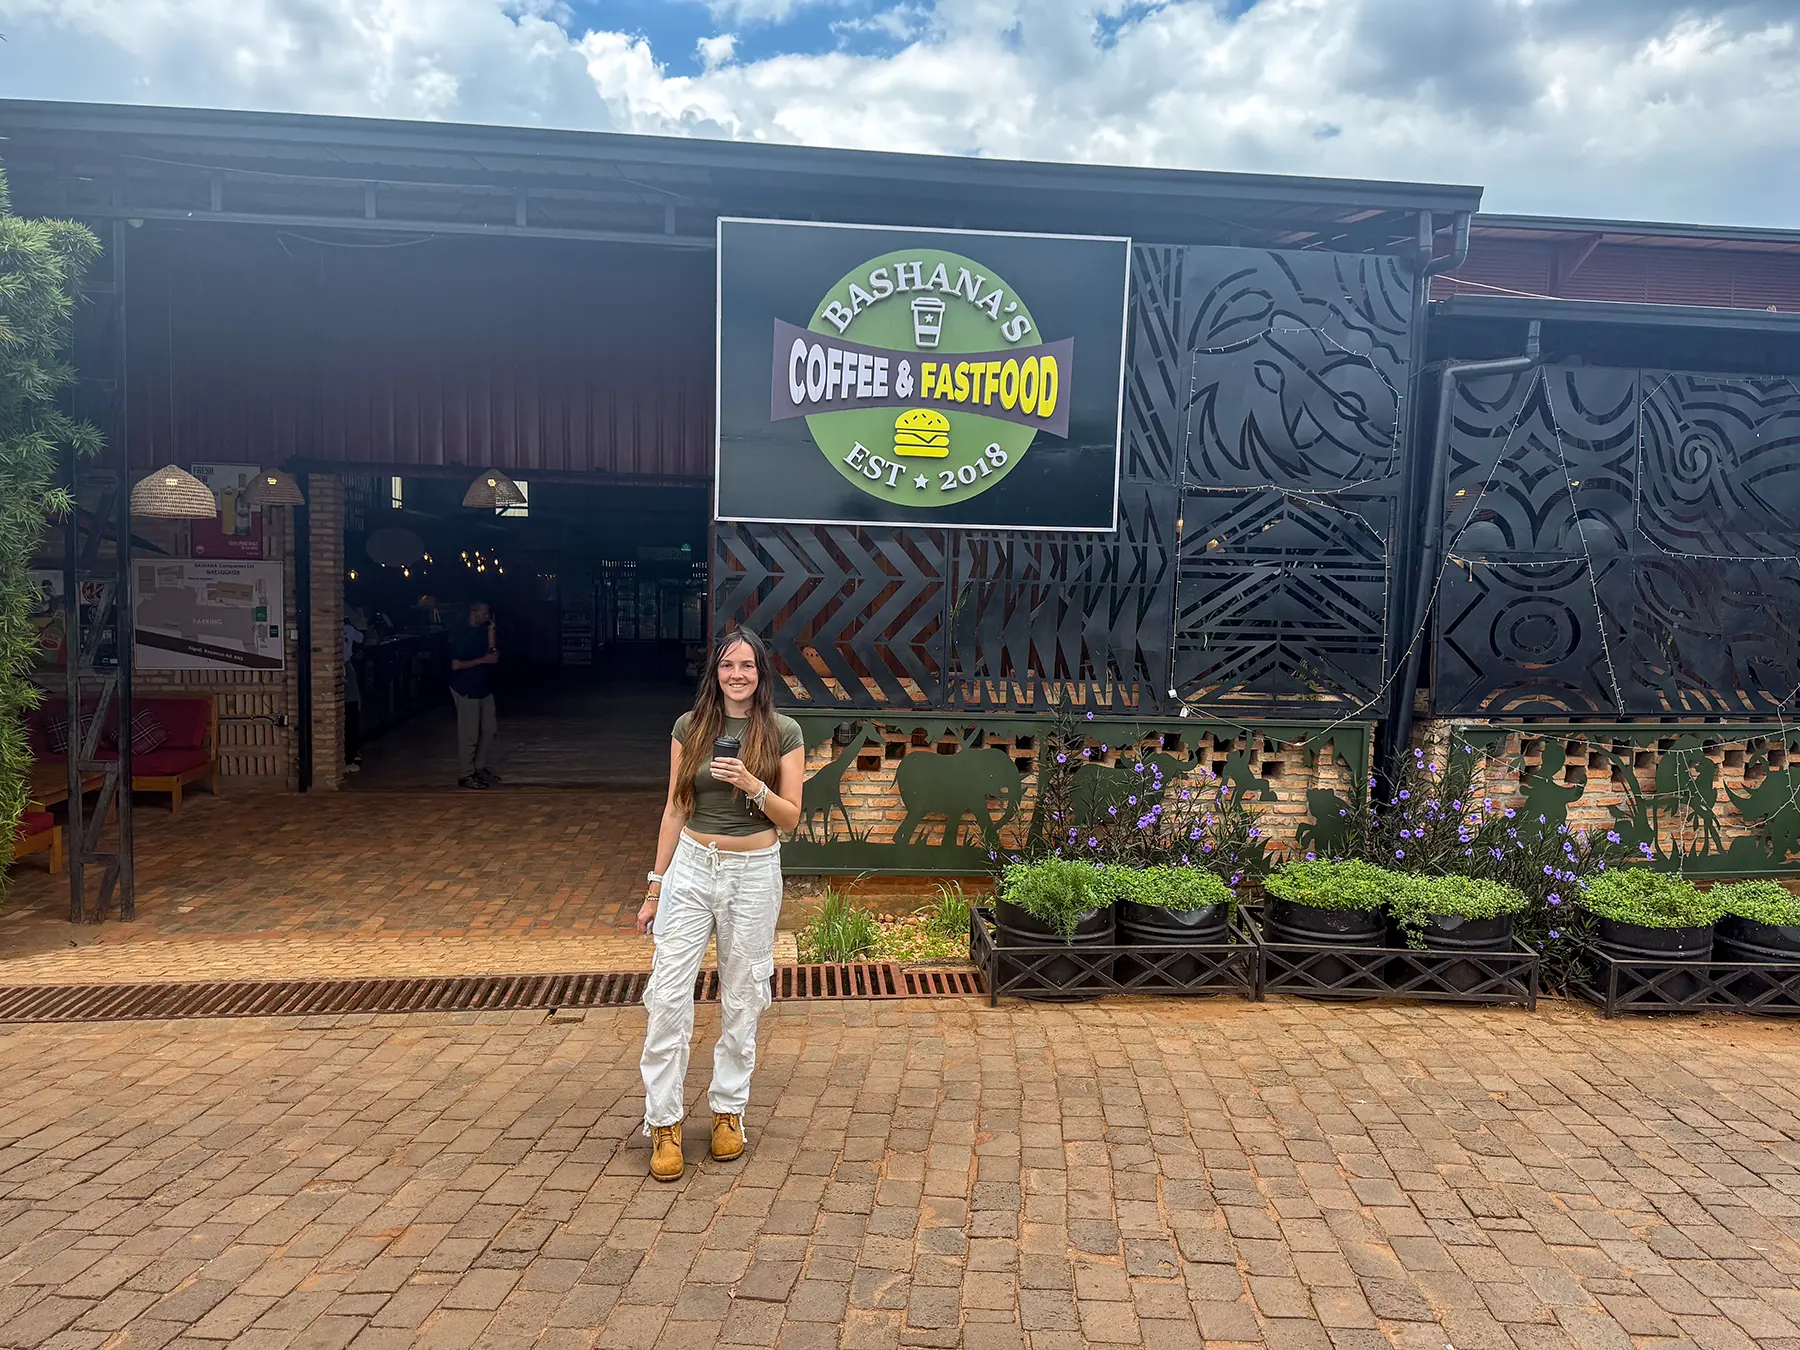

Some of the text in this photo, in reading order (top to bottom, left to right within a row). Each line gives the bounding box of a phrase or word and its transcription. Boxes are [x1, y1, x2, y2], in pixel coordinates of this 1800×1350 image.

[820, 261, 1033, 344] BASHANA'S
[788, 337, 1059, 419] COFFEE & FASTFOOD
[193, 466, 214, 475] FRESH
[842, 441, 1009, 491] EST 2018
